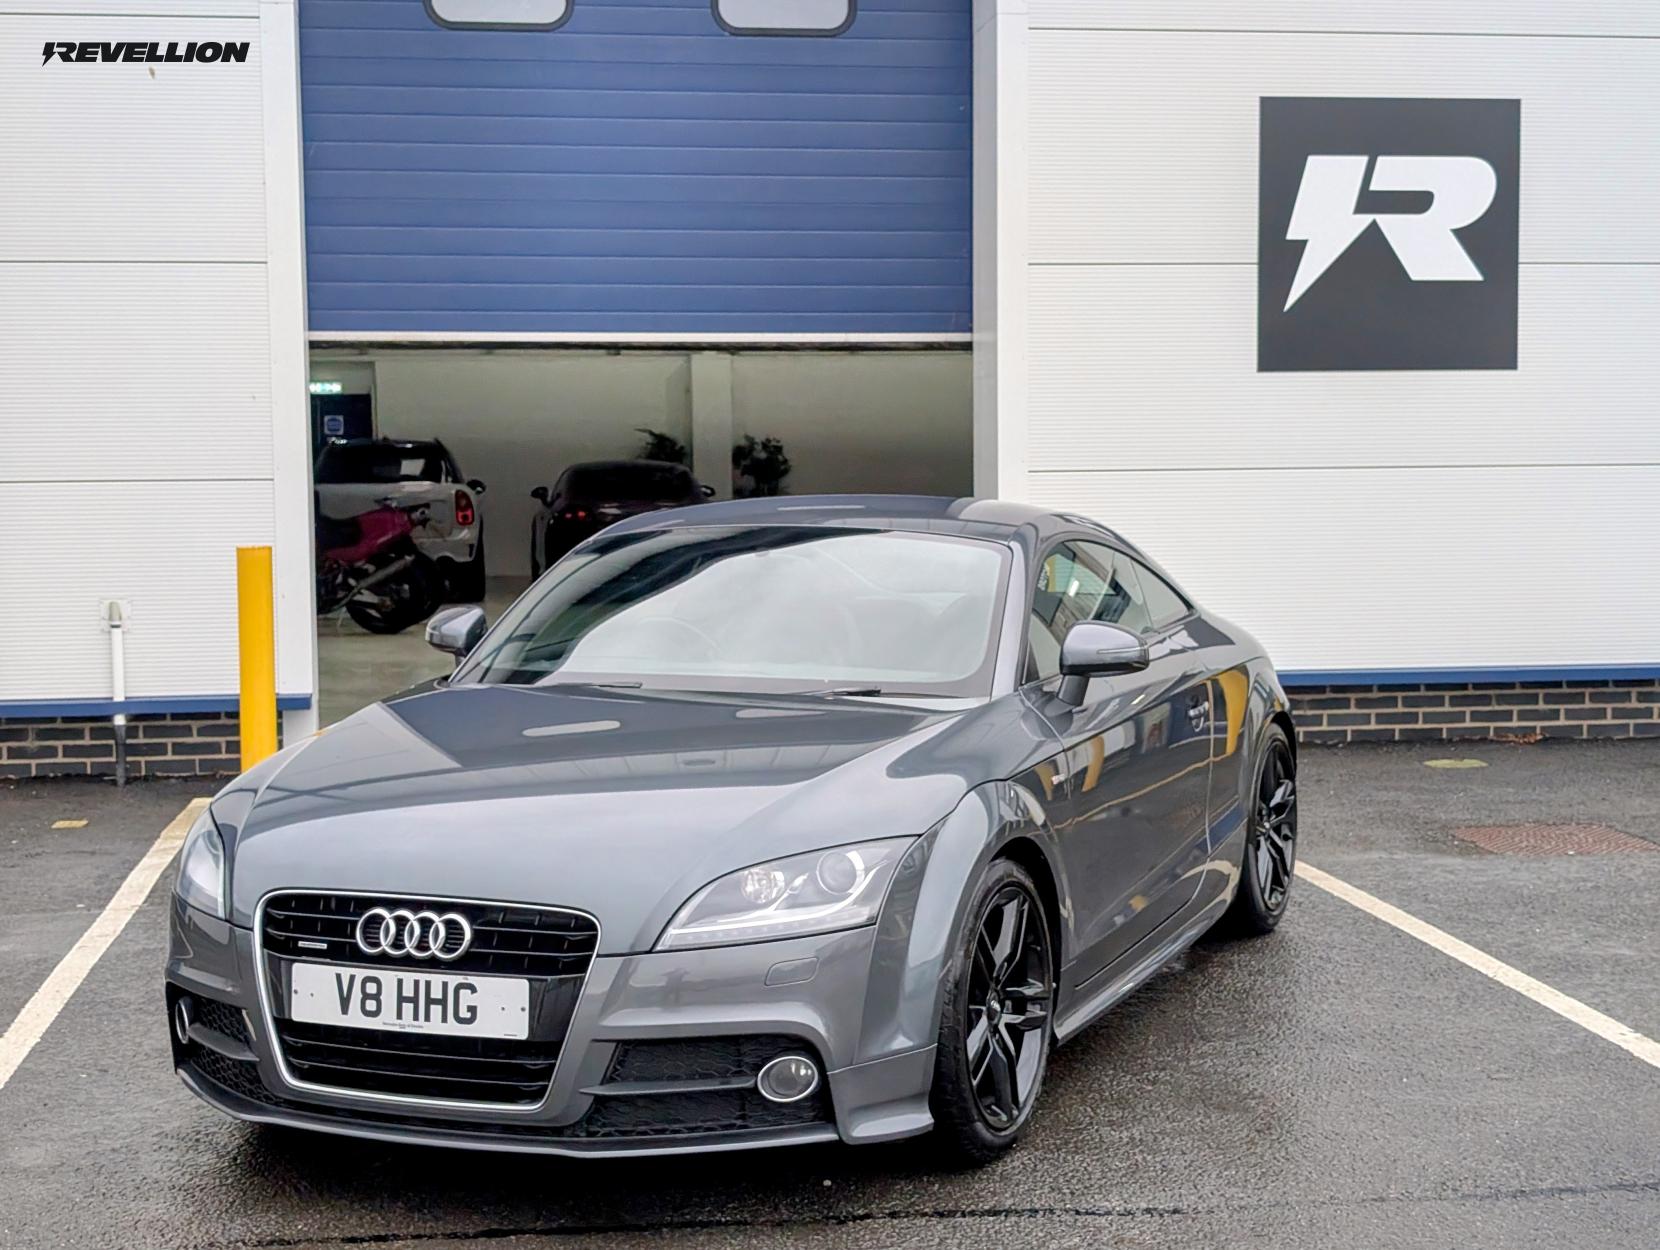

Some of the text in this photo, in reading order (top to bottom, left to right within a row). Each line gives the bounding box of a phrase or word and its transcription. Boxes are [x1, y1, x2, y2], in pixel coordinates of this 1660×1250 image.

[1283, 155, 1498, 312] R
[335, 972, 478, 1025] V8 HHG
